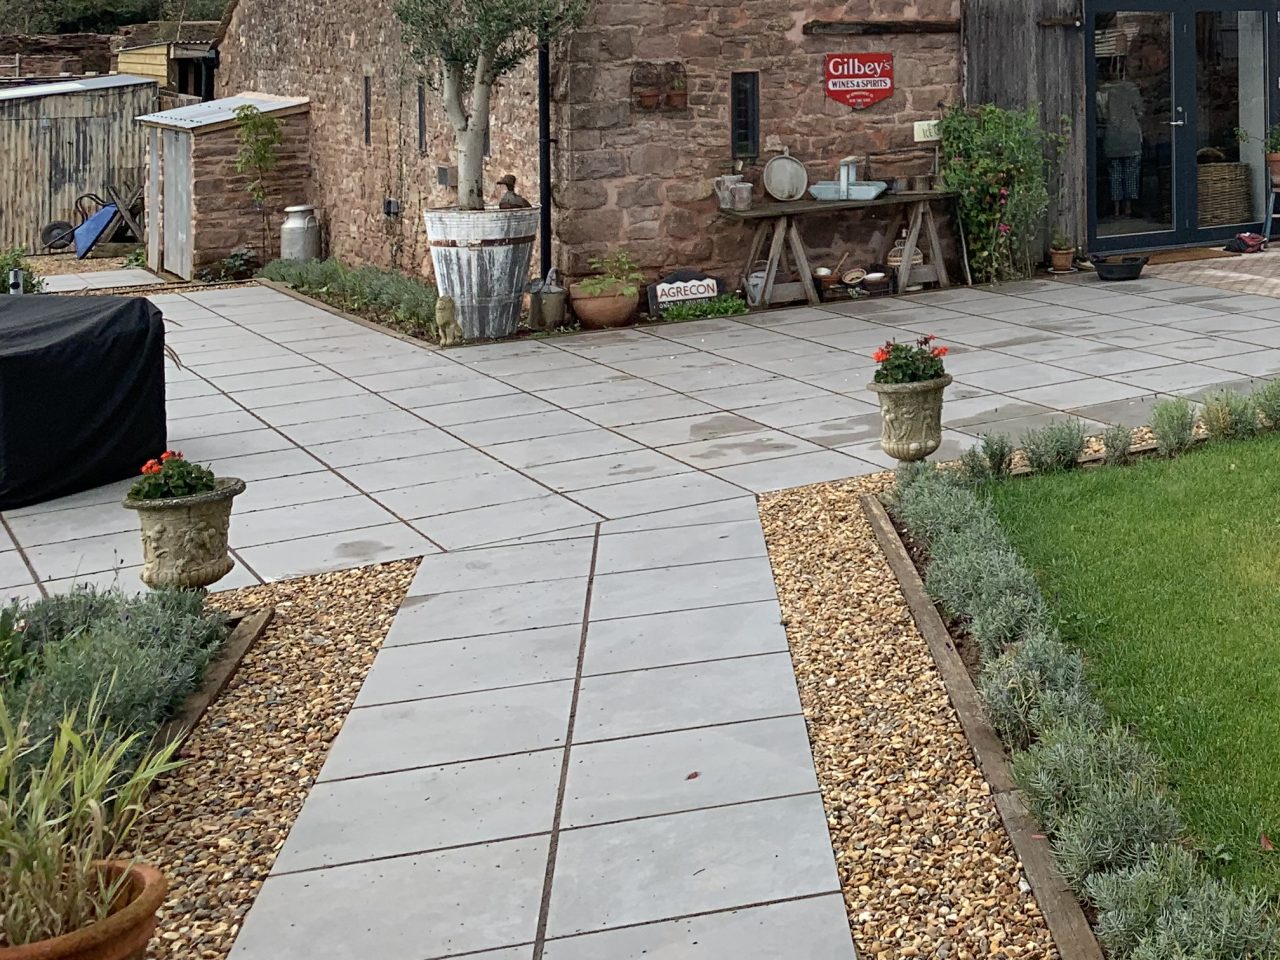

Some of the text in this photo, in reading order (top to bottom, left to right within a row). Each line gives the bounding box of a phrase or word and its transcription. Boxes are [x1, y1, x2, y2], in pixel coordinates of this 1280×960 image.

[829, 58, 891, 77] Gilbey's
[831, 80, 855, 89] WINES
[861, 78, 888, 88] SPIRITS
[660, 283, 715, 298] AGRECON
